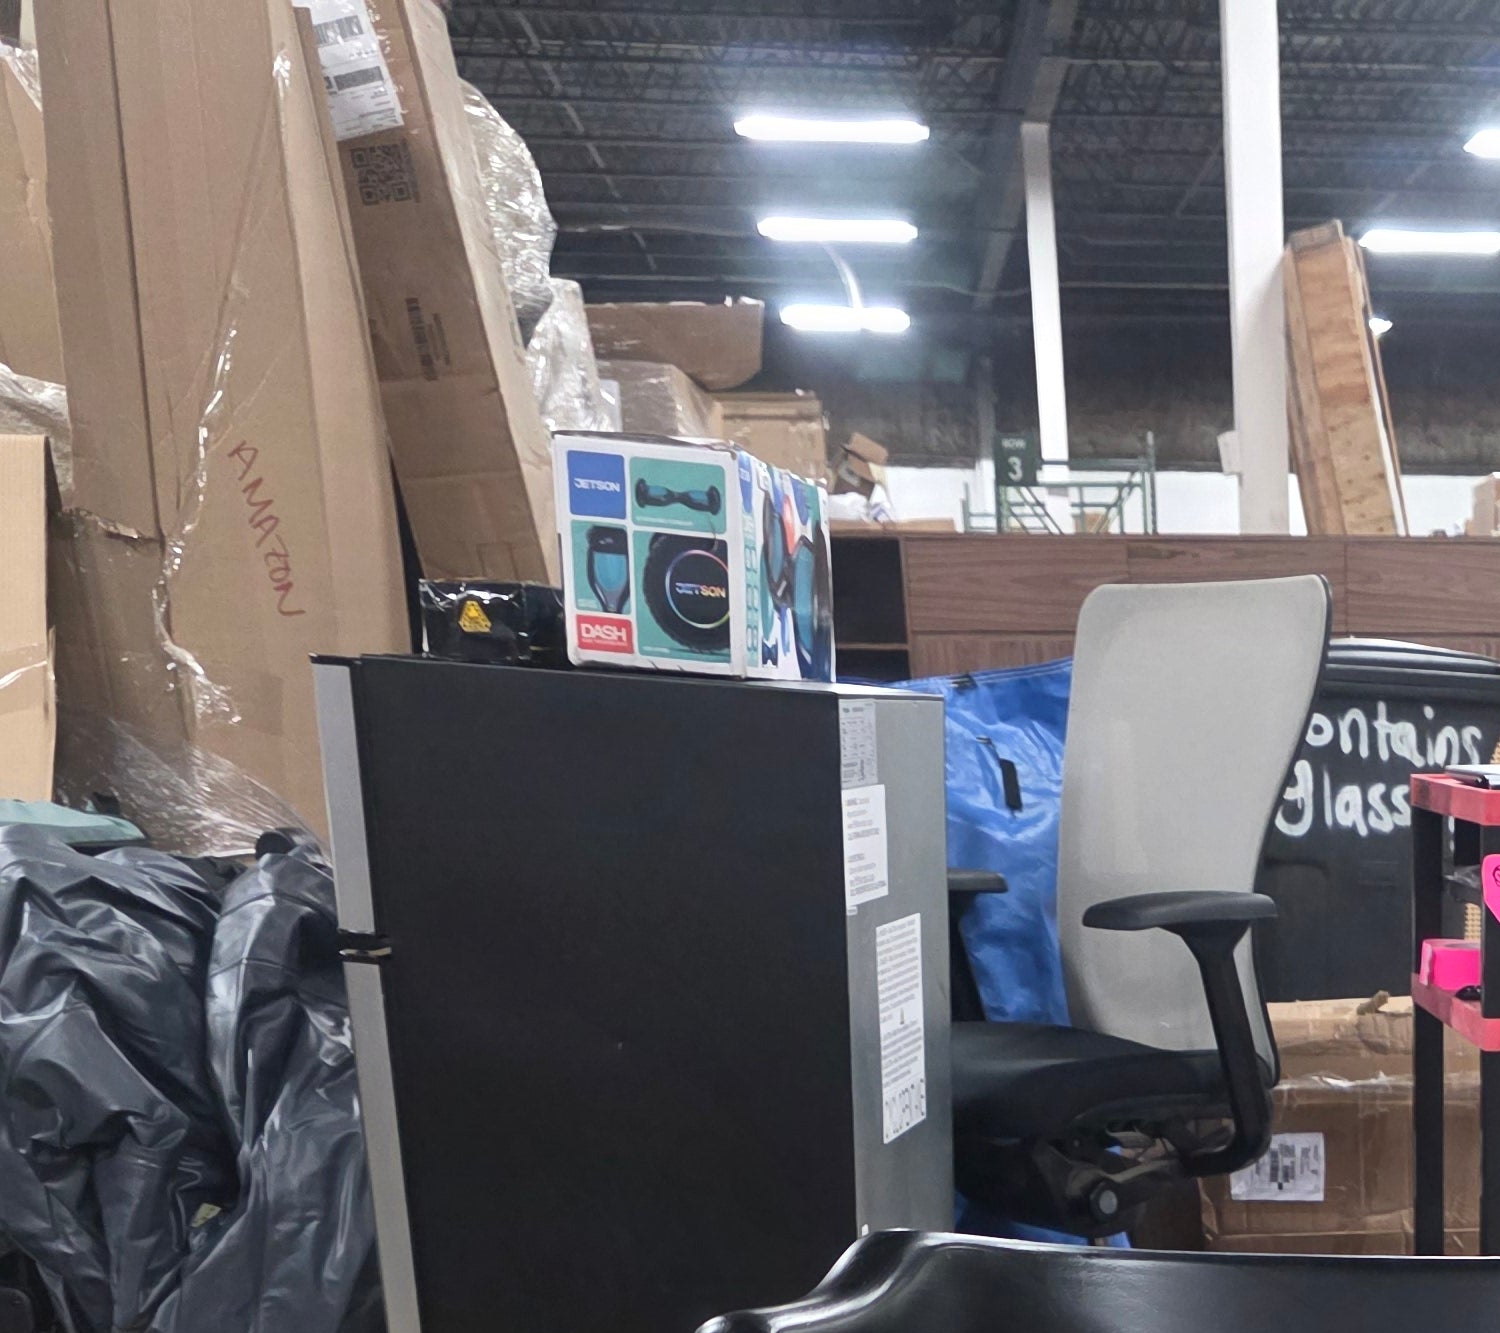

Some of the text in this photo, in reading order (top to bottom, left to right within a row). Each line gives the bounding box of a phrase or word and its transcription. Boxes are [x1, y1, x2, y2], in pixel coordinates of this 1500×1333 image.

[1007, 455, 1023, 482] 3
[574, 477, 620, 493] JETSON
[227, 440, 306, 616] AMAZON
[675, 581, 726, 599] JETSON
[580, 623, 627, 642] DASH
